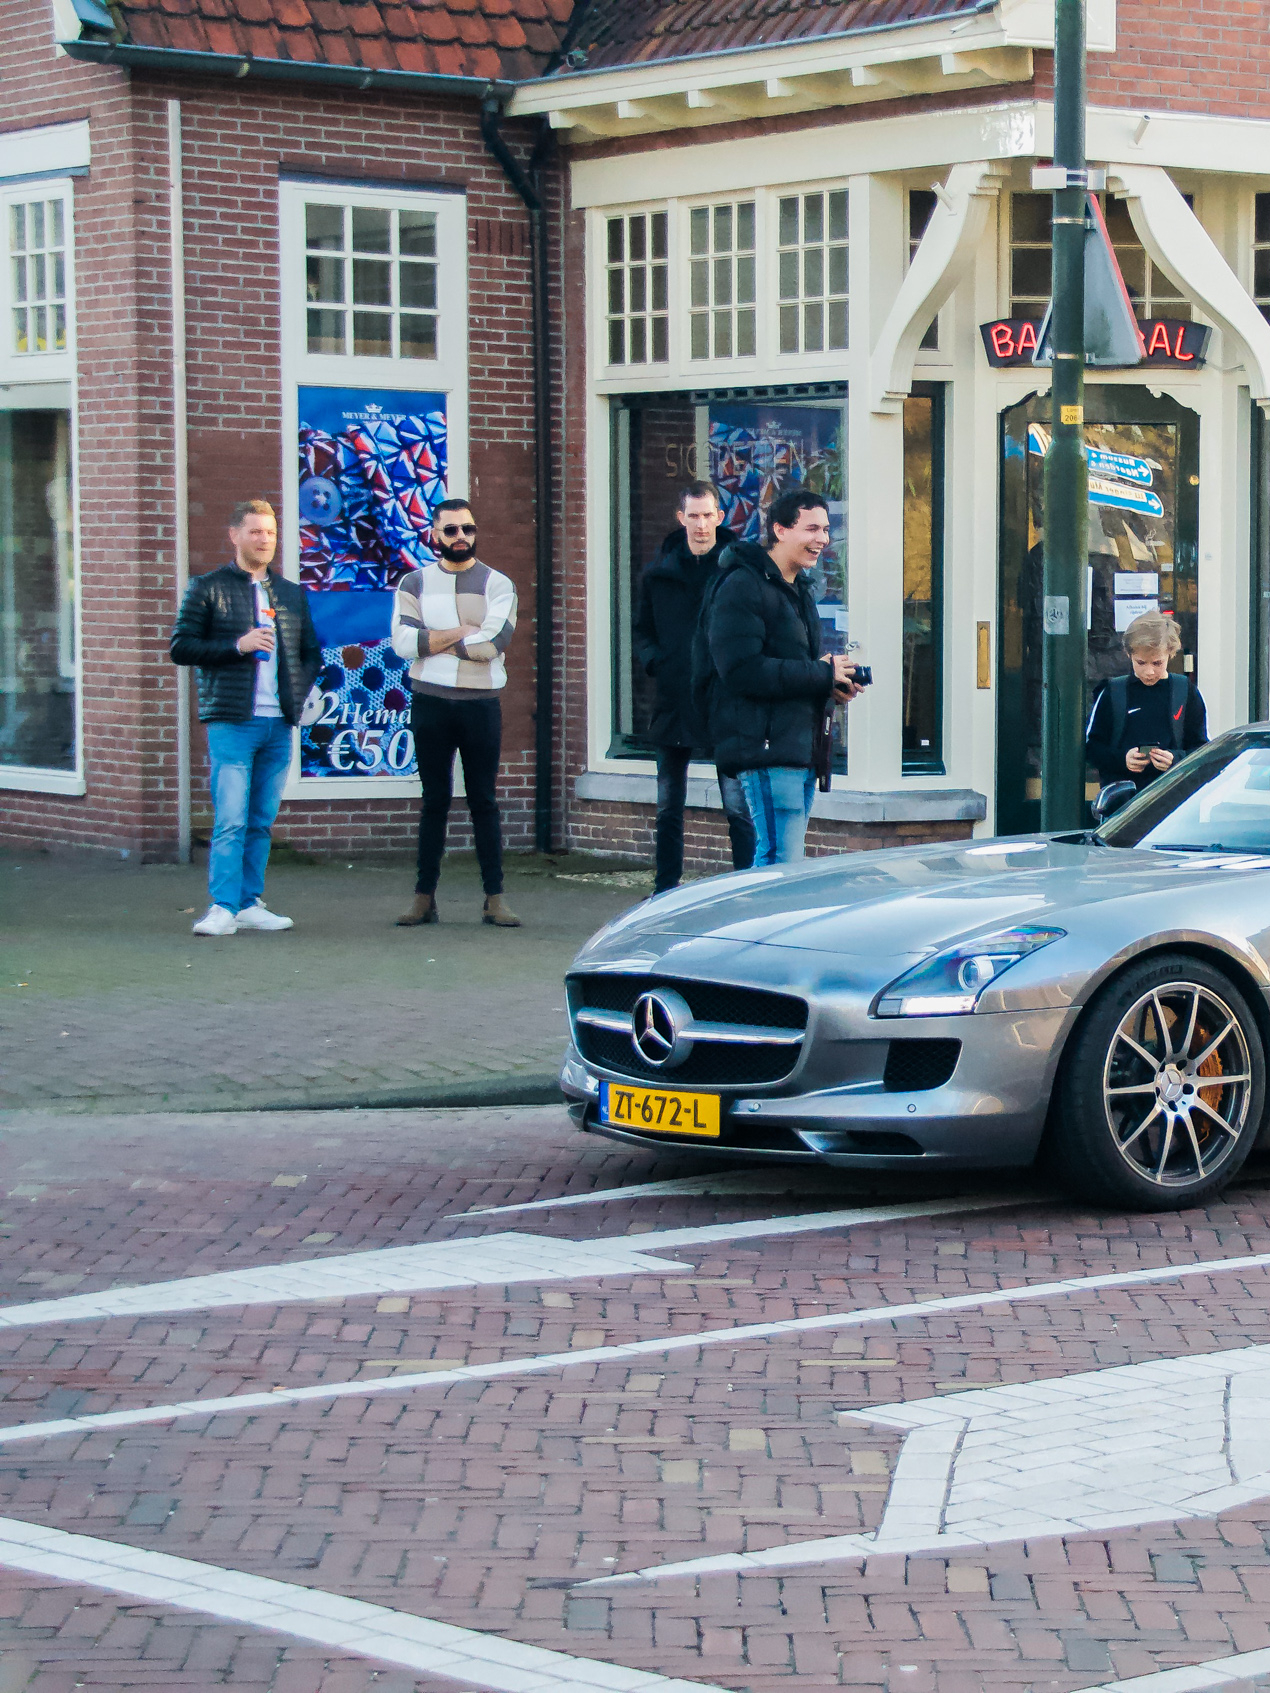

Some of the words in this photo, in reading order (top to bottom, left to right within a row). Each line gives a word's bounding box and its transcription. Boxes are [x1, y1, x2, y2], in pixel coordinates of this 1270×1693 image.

[341, 411, 369, 420] MEYER
[371, 412, 378, 420] &
[614, 1090, 707, 1128] ZT-672-L
